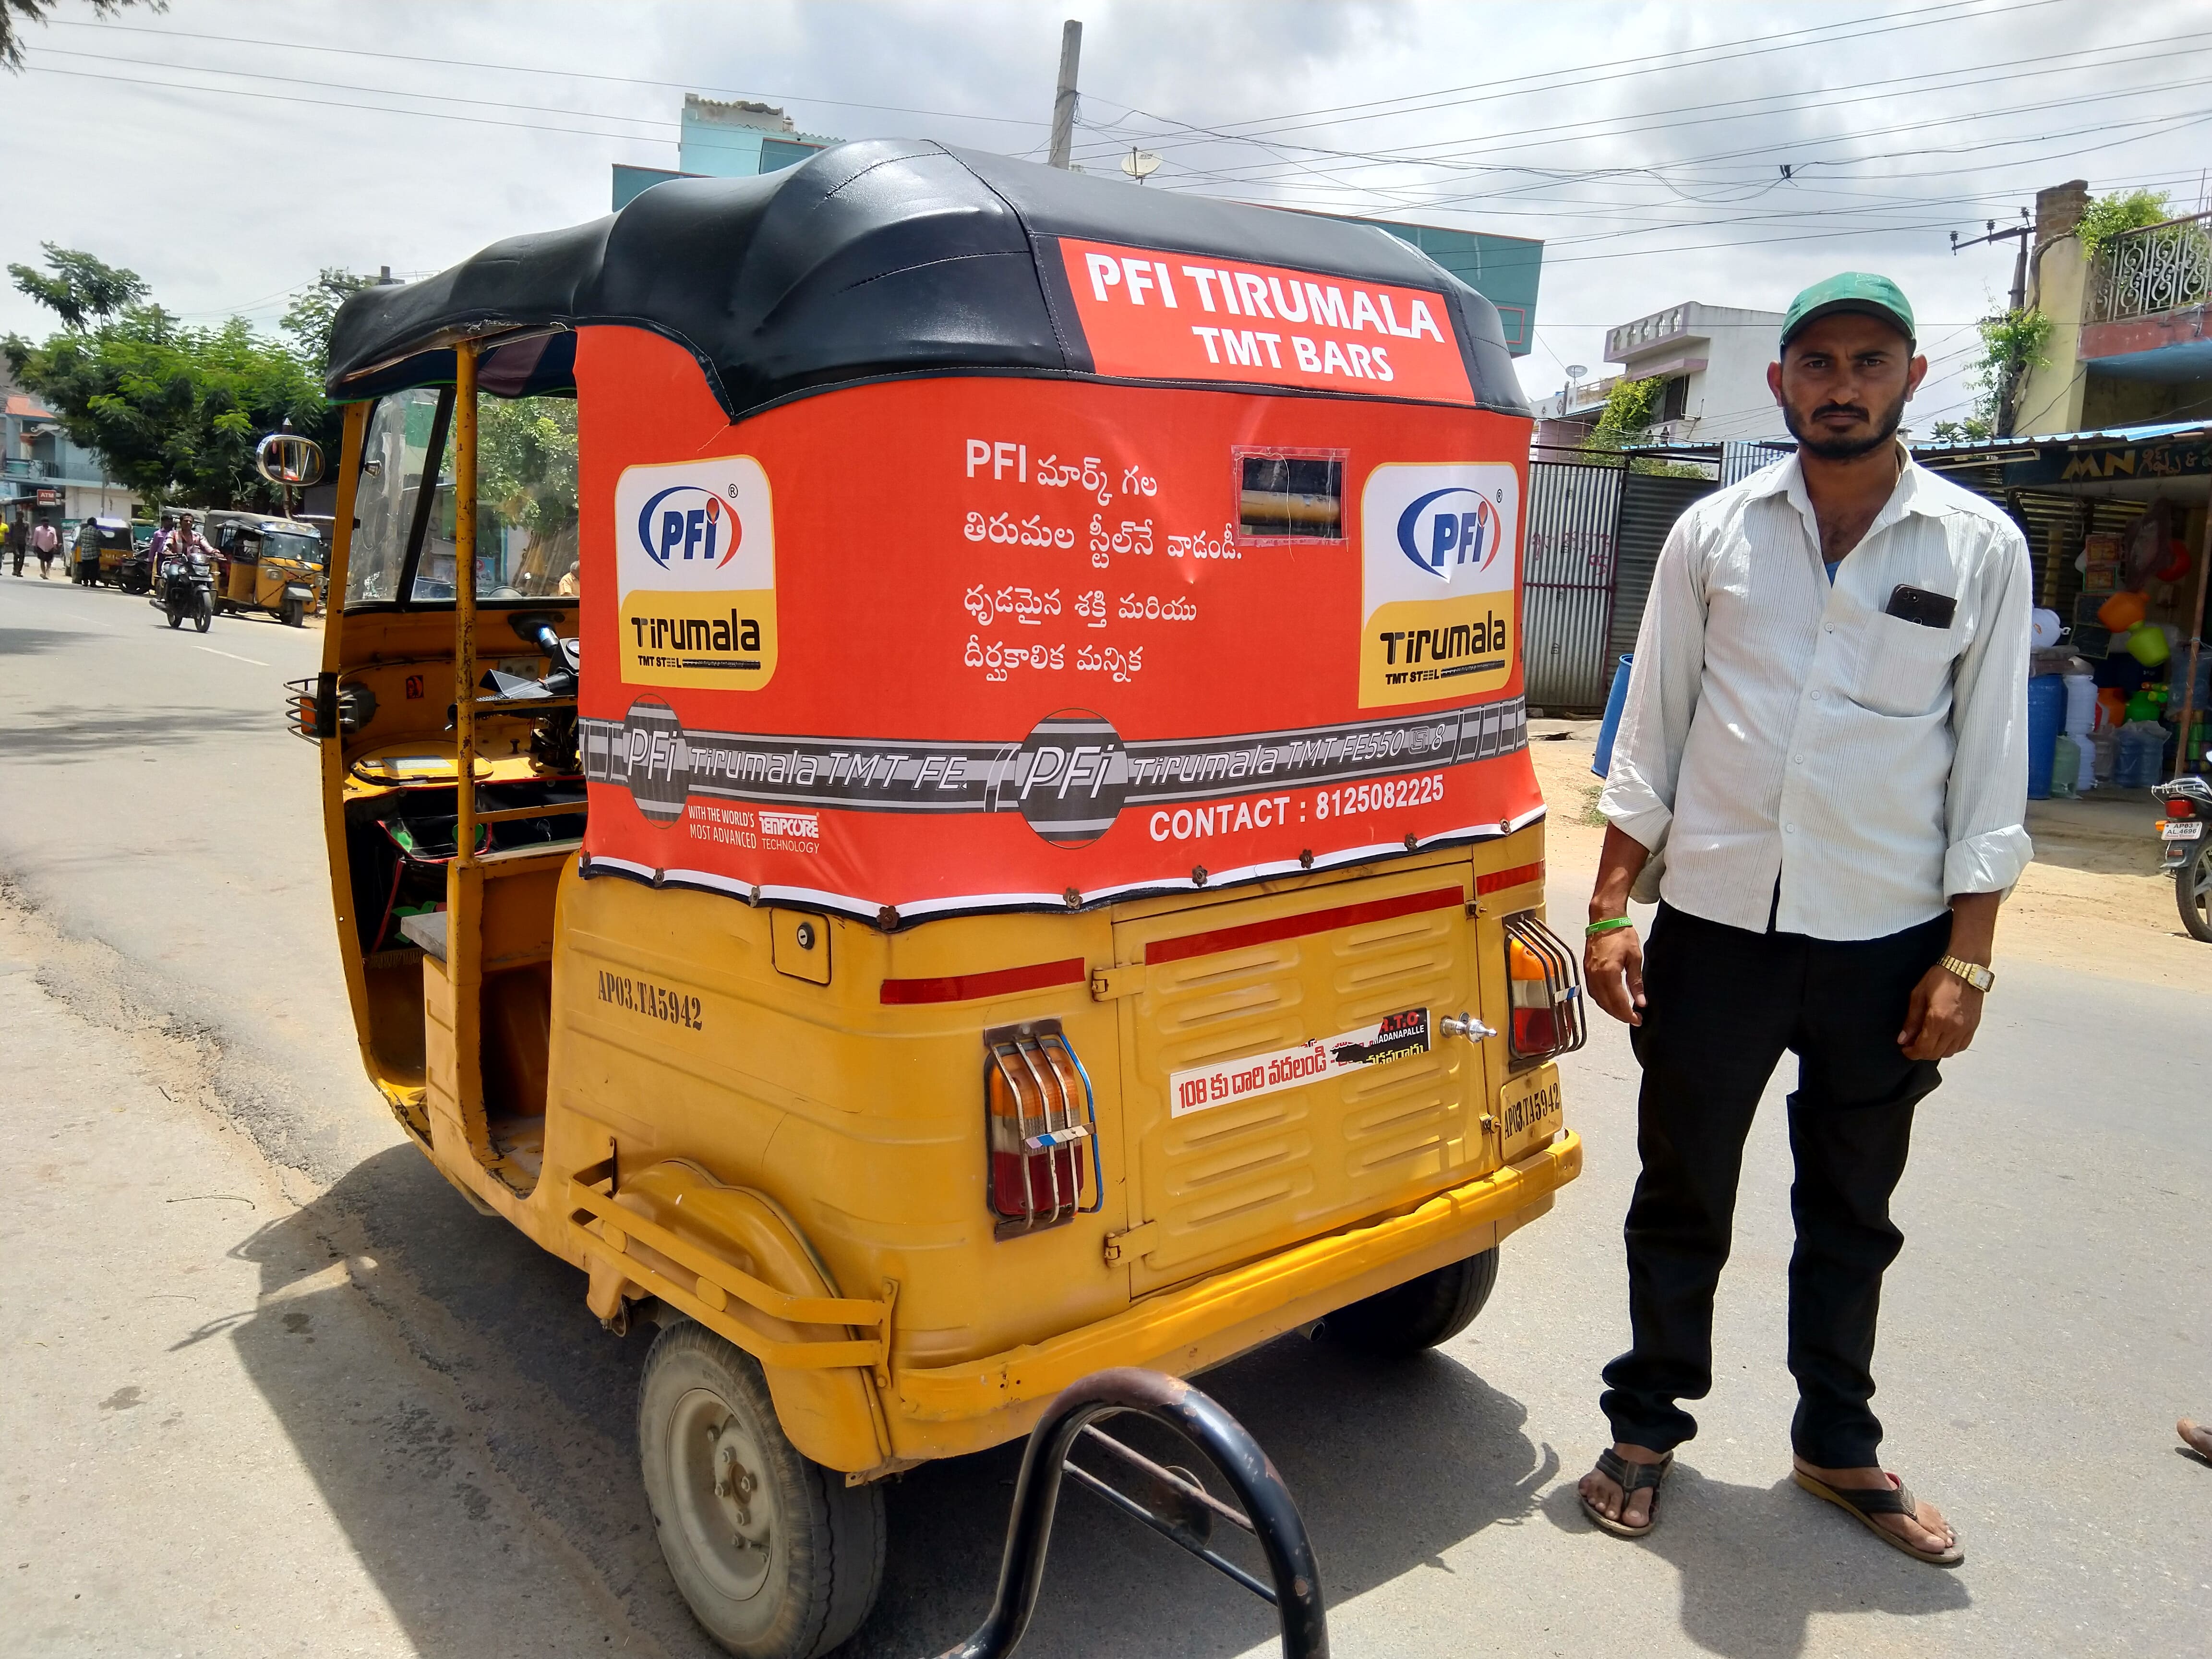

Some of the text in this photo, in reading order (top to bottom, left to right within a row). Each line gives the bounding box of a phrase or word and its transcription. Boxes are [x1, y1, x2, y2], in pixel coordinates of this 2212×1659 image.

[1085, 253, 1445, 343] PFI TIRUMALA
[1191, 325, 1395, 383] TMT BARS
[967, 439, 1026, 483] PFI
[1122, 465, 1157, 497] గల
[2061, 449, 2136, 480] MN
[963, 511, 1075, 549] తిరుమల
[964, 584, 1197, 628] ధృడమైన శక్తి మరియు
[631, 608, 761, 651] Tirumala
[1380, 610, 1506, 665] Tirumala
[637, 655, 654, 667] TMT
[656, 657, 682, 669] STEEL
[964, 634, 1143, 683] దీర్ఘకాలిక మన్నిక
[1385, 669, 1440, 685] TMT STEEL
[691, 748, 818, 786] Tirumala
[827, 752, 911, 789] TMT
[912, 756, 967, 790] FE
[1133, 743, 1279, 786] Tirumala
[1286, 737, 1338, 770] TMT
[1338, 728, 1405, 765] FE550
[688, 805, 755, 828] WITH THE WORLD'S
[758, 811, 819, 838] TEMPCORE
[1150, 797, 1290, 842] CONTACT
[1316, 774, 1444, 820] 8125082225
[690, 824, 757, 849] MOST ADVANCED
[762, 838, 820, 854] TECHNOLOGY
[598, 970, 702, 1031] AP03.TA5942
[1179, 1045, 1326, 1108] 108 కు దారి వదలండి
[1504, 1082, 1560, 1140] AP03.TA5942
